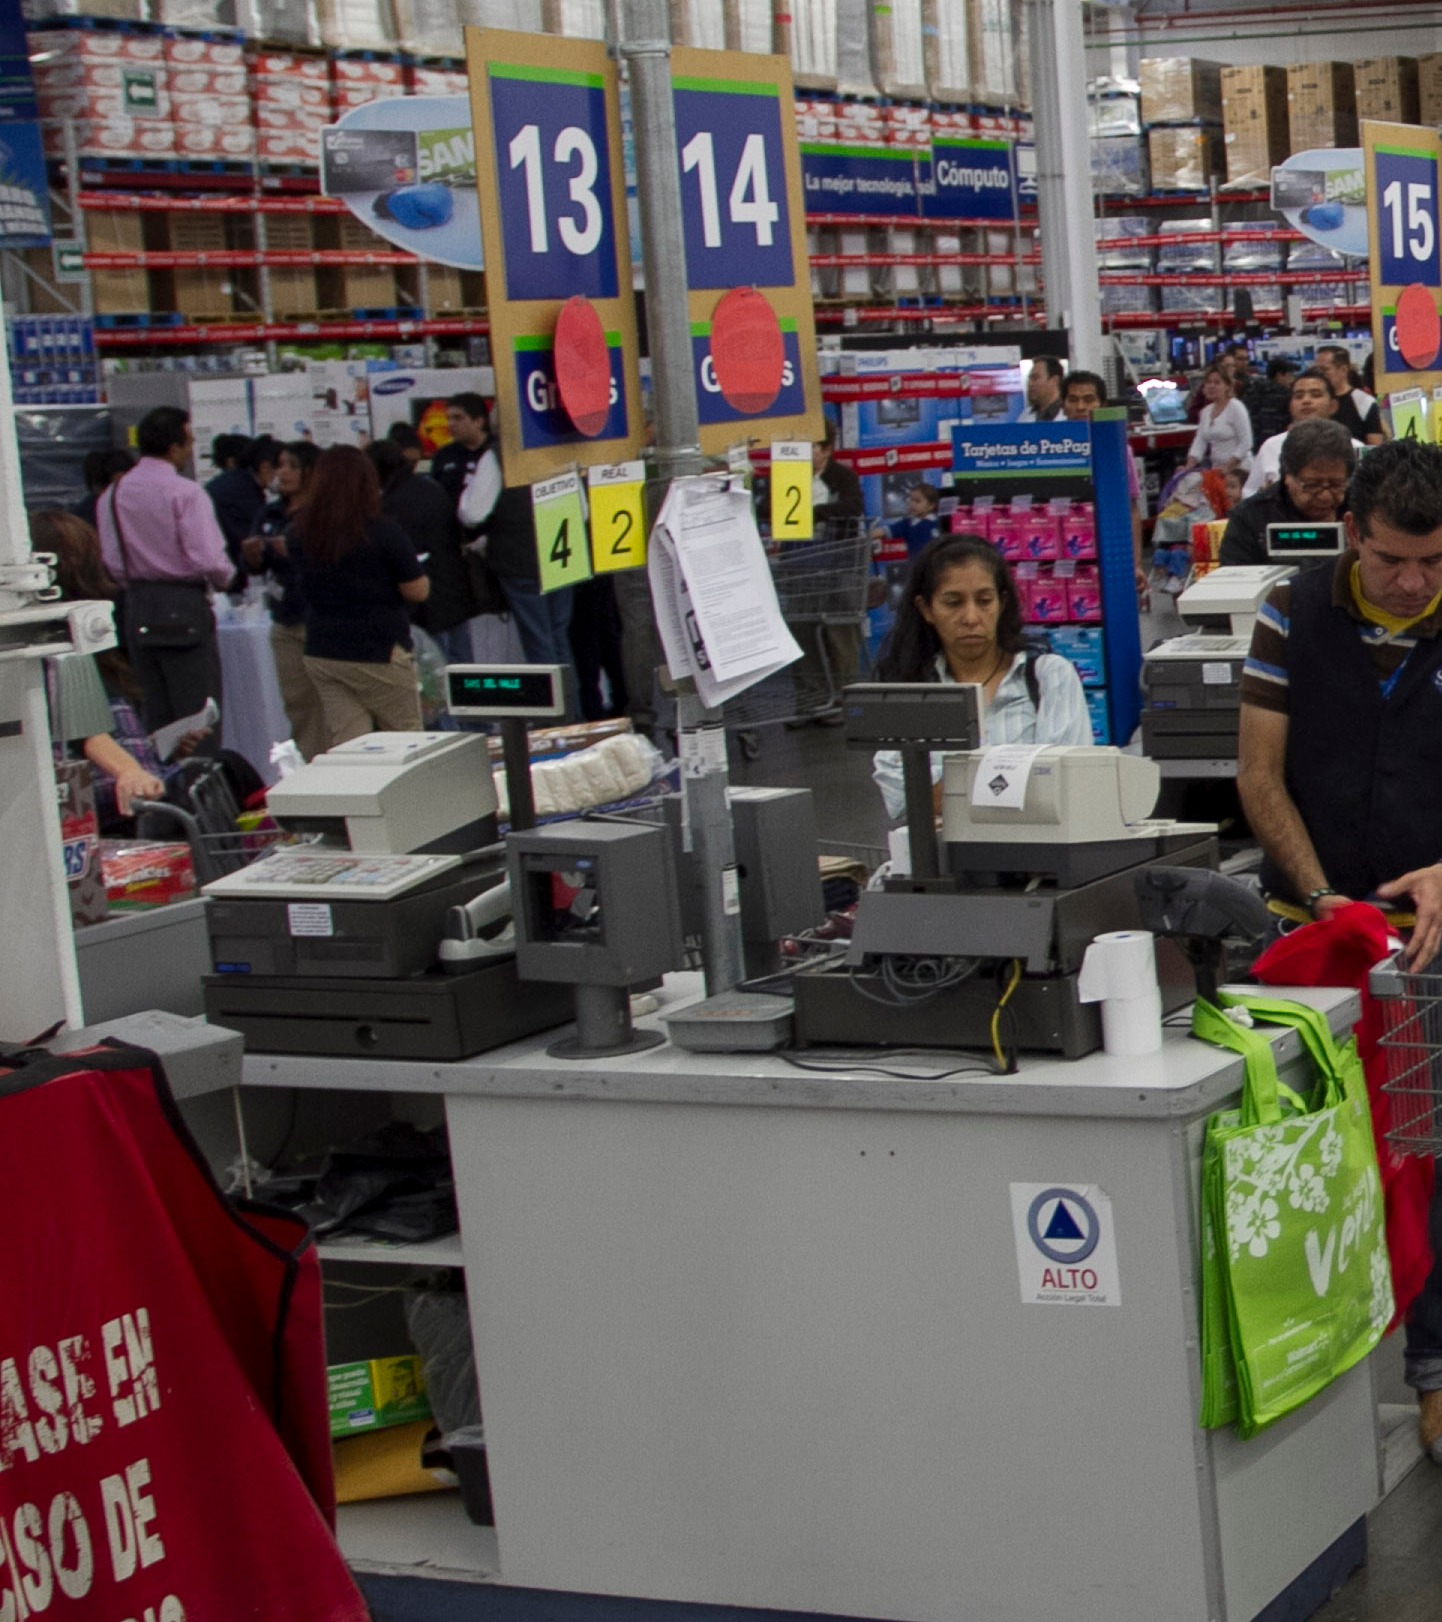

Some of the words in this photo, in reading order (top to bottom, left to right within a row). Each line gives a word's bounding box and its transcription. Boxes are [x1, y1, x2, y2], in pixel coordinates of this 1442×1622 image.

[508, 124, 604, 256] 13
[682, 131, 780, 248] 14
[805, 173, 820, 189] La
[822, 175, 854, 195] mejor
[936, 159, 1009, 193] Cómputo
[1383, 180, 1435, 262] 15
[1406, 416, 1417, 438] 4
[780, 446, 800, 457] REAL
[961, 441, 1018, 458] Tarjetas
[1020, 440, 1038, 455] de
[535, 478, 576, 498] OBJETIVO
[601, 468, 628, 480] REAL
[784, 486, 801, 526] 2
[549, 518, 572, 568] 4
[611, 510, 634, 555] 2
[1033, 766, 1053, 776] IBM
[1041, 1267, 1098, 1289] ALTO
[100, 1308, 162, 1430] EN
[100, 1458, 166, 1584] DE
